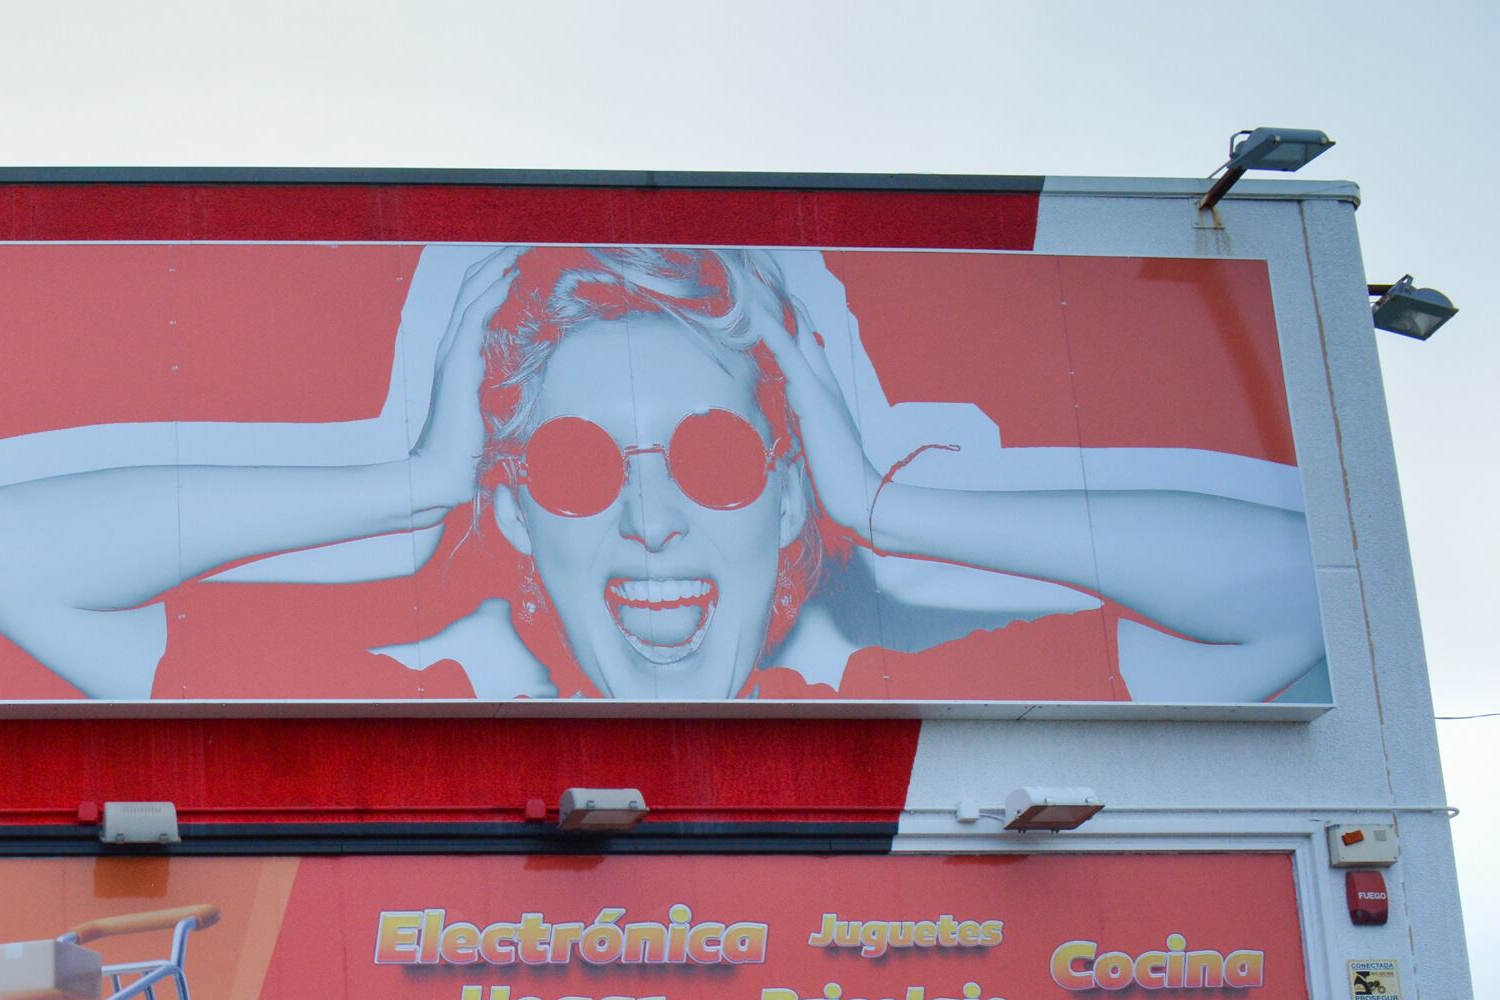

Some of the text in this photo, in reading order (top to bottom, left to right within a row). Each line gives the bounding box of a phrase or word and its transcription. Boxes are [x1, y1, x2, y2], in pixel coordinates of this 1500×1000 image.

[1358, 891, 1387, 900] FUEGO
[373, 904, 768, 964] Electrónica
[808, 913, 1004, 958] Juguetes
[1050, 933, 1264, 989] Cocina
